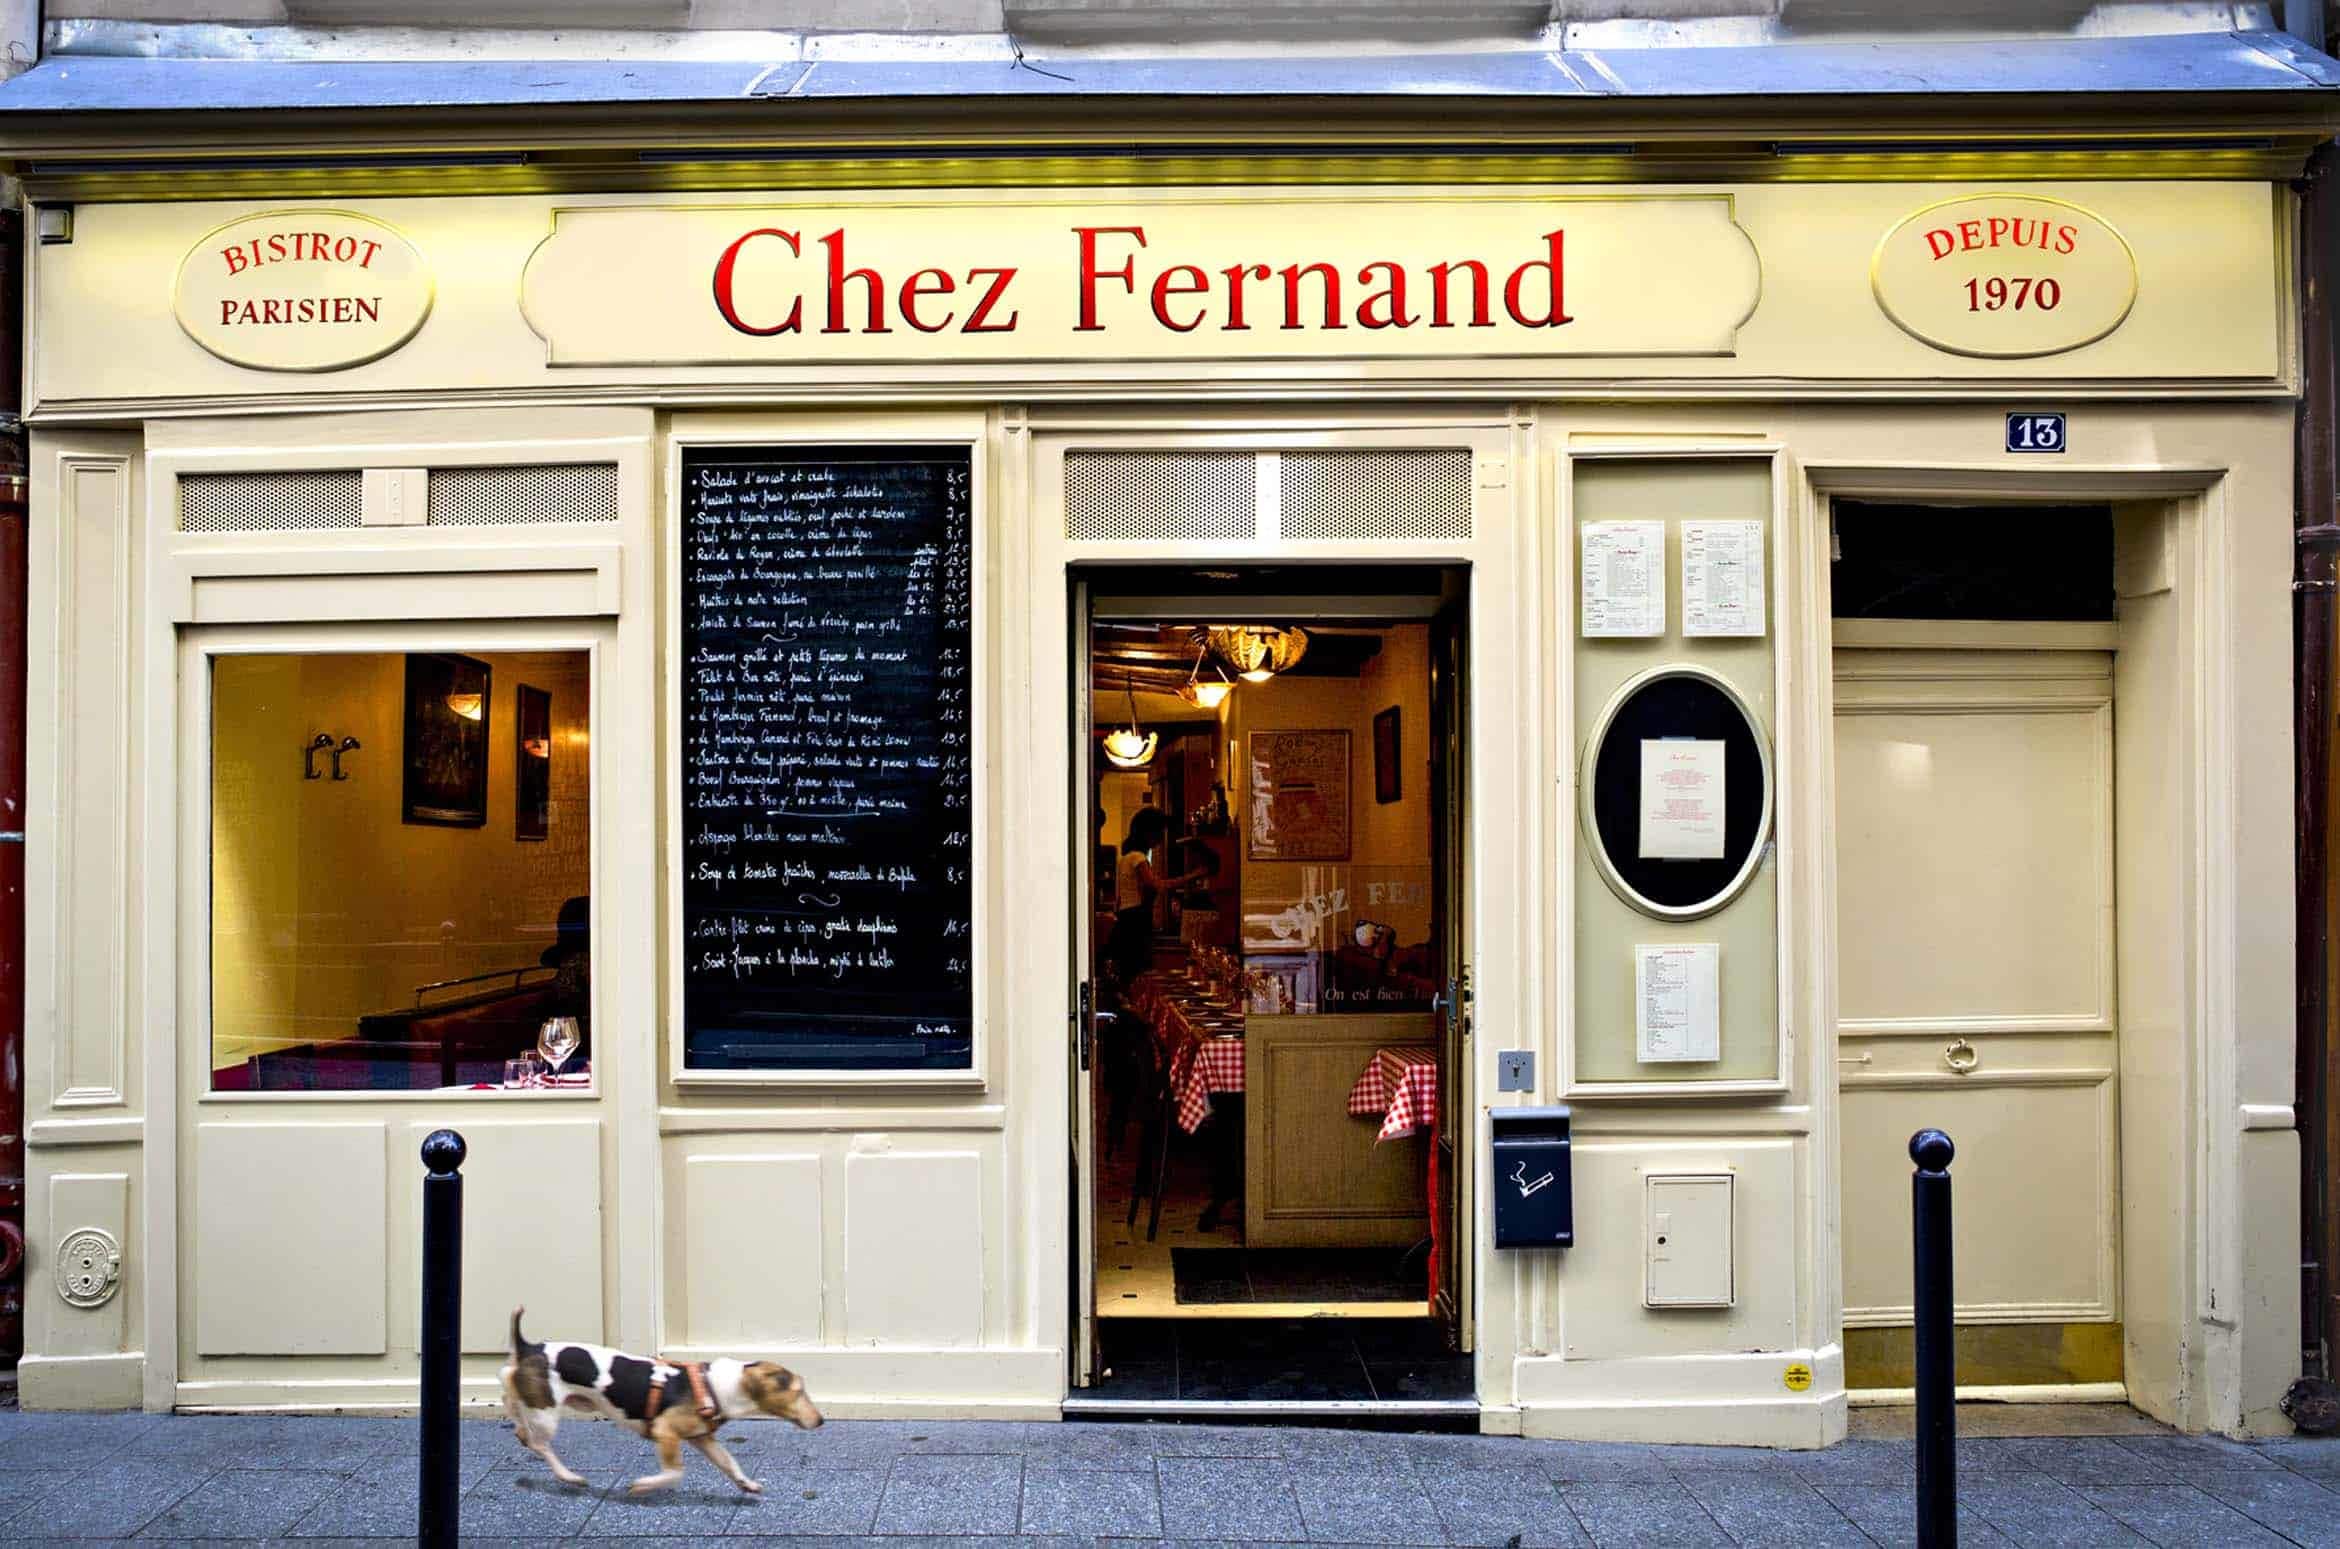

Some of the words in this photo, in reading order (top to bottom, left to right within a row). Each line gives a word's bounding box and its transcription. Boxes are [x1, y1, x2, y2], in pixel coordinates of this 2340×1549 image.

[1924, 217, 2079, 261] DEPUIS
[221, 233, 382, 276] BISTROT
[712, 227, 1019, 337] Chez
[1071, 226, 1575, 333] Fernand
[1964, 277, 2061, 312] 1970
[221, 297, 382, 325] PARISIEN
[2018, 417, 2058, 448] 13
[701, 469, 738, 489] Salade
[744, 468, 786, 484] d'avocat
[790, 468, 803, 483] et
[807, 465, 835, 481] crabe
[700, 490, 733, 511] Haricots
[739, 490, 758, 503] verts
[791, 486, 838, 508] vinaigrette
[696, 511, 723, 533] Soupe
[725, 510, 736, 524] de
[740, 509, 770, 531] légumes
[830, 506, 856, 528] poché
[858, 507, 868, 519] et
[870, 505, 906, 520] lardons
[838, 528, 848, 540] de
[735, 547, 746, 560] de
[811, 546, 821, 558] de
[696, 567, 736, 590] Escargots
[739, 567, 750, 581] de
[734, 592, 744, 606] de
[747, 591, 768, 606] notre
[732, 614, 743, 629] de
[780, 610, 806, 637] fumé
[854, 620, 876, 636] pain
[879, 617, 902, 638] grillé
[697, 647, 737, 664] Saumon
[739, 646, 769, 671] grillé
[772, 647, 785, 663] et
[787, 647, 812, 673] petits
[871, 647, 909, 663] moment
[697, 667, 723, 685] Filet
[726, 668, 736, 683] de
[697, 687, 726, 703] Poulet
[712, 705, 756, 731] Hamburger
[833, 711, 844, 723] et
[845, 706, 886, 733] fromage
[714, 728, 757, 753] Hamburger
[760, 728, 791, 745] Canard
[813, 752, 841, 767] salade
[698, 822, 737, 856] Asperges
[698, 861, 723, 892] Soupe
[743, 860, 779, 880] tomates
[827, 864, 873, 882] mozzarella
[1270, 888, 1349, 939] CHEZ
[777, 947, 787, 964] la
[1325, 986, 1345, 1001] On
[1351, 987, 1371, 1001] est
